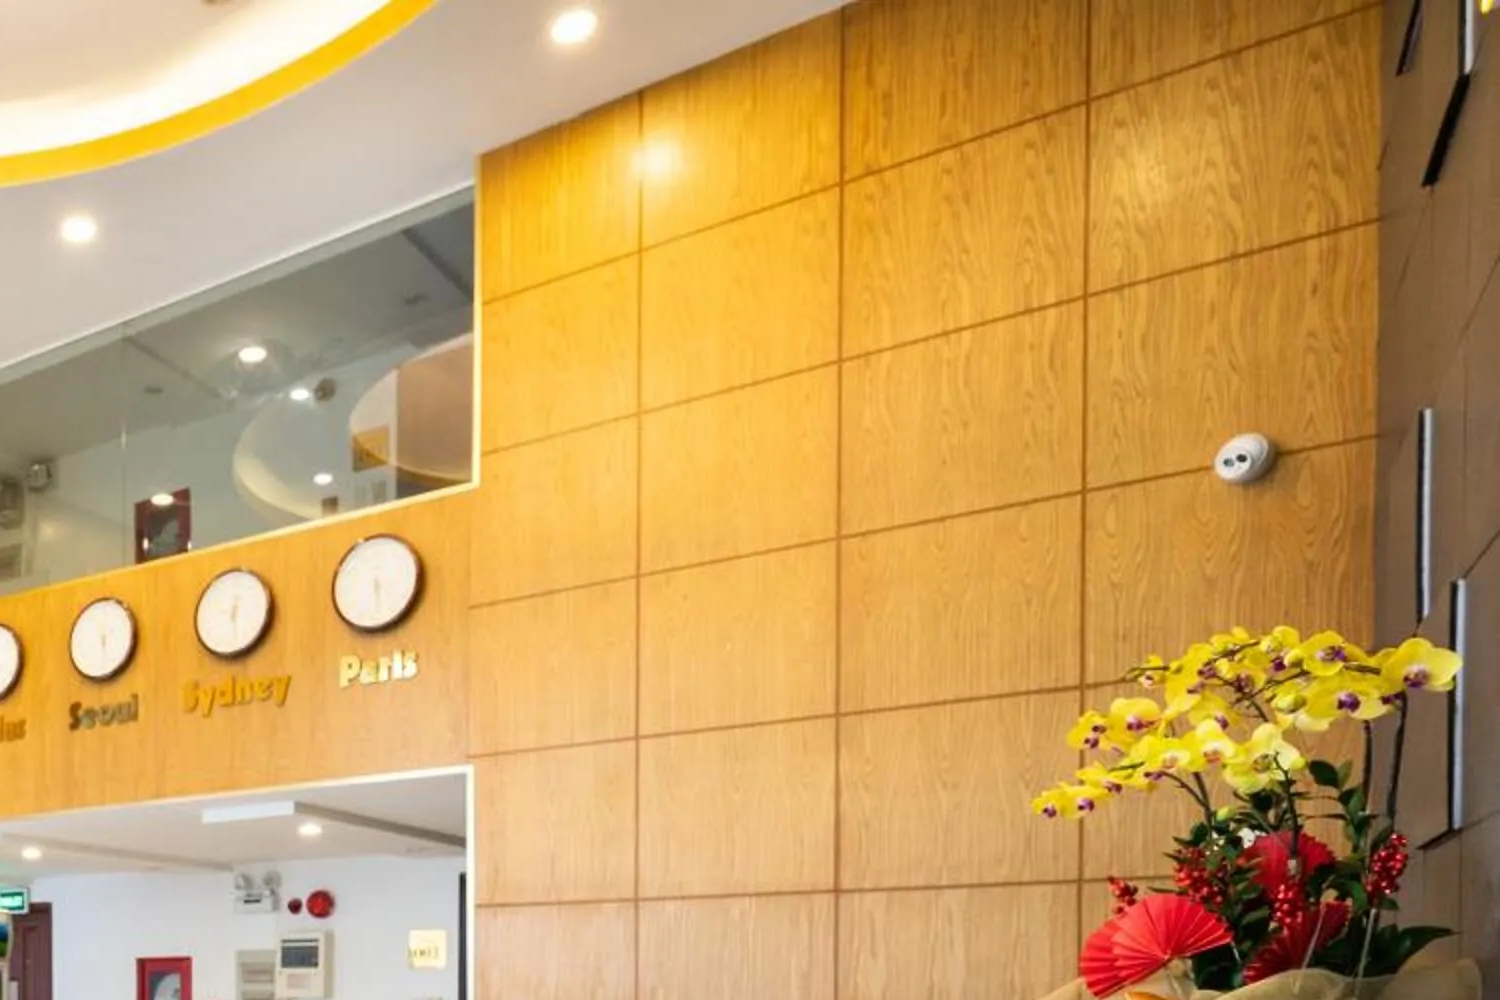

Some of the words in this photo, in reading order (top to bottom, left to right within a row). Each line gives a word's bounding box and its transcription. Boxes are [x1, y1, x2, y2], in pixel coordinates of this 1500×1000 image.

[339, 649, 418, 688] Paris
[68, 693, 140, 731] Seoul
[182, 674, 291, 718] Sydney
